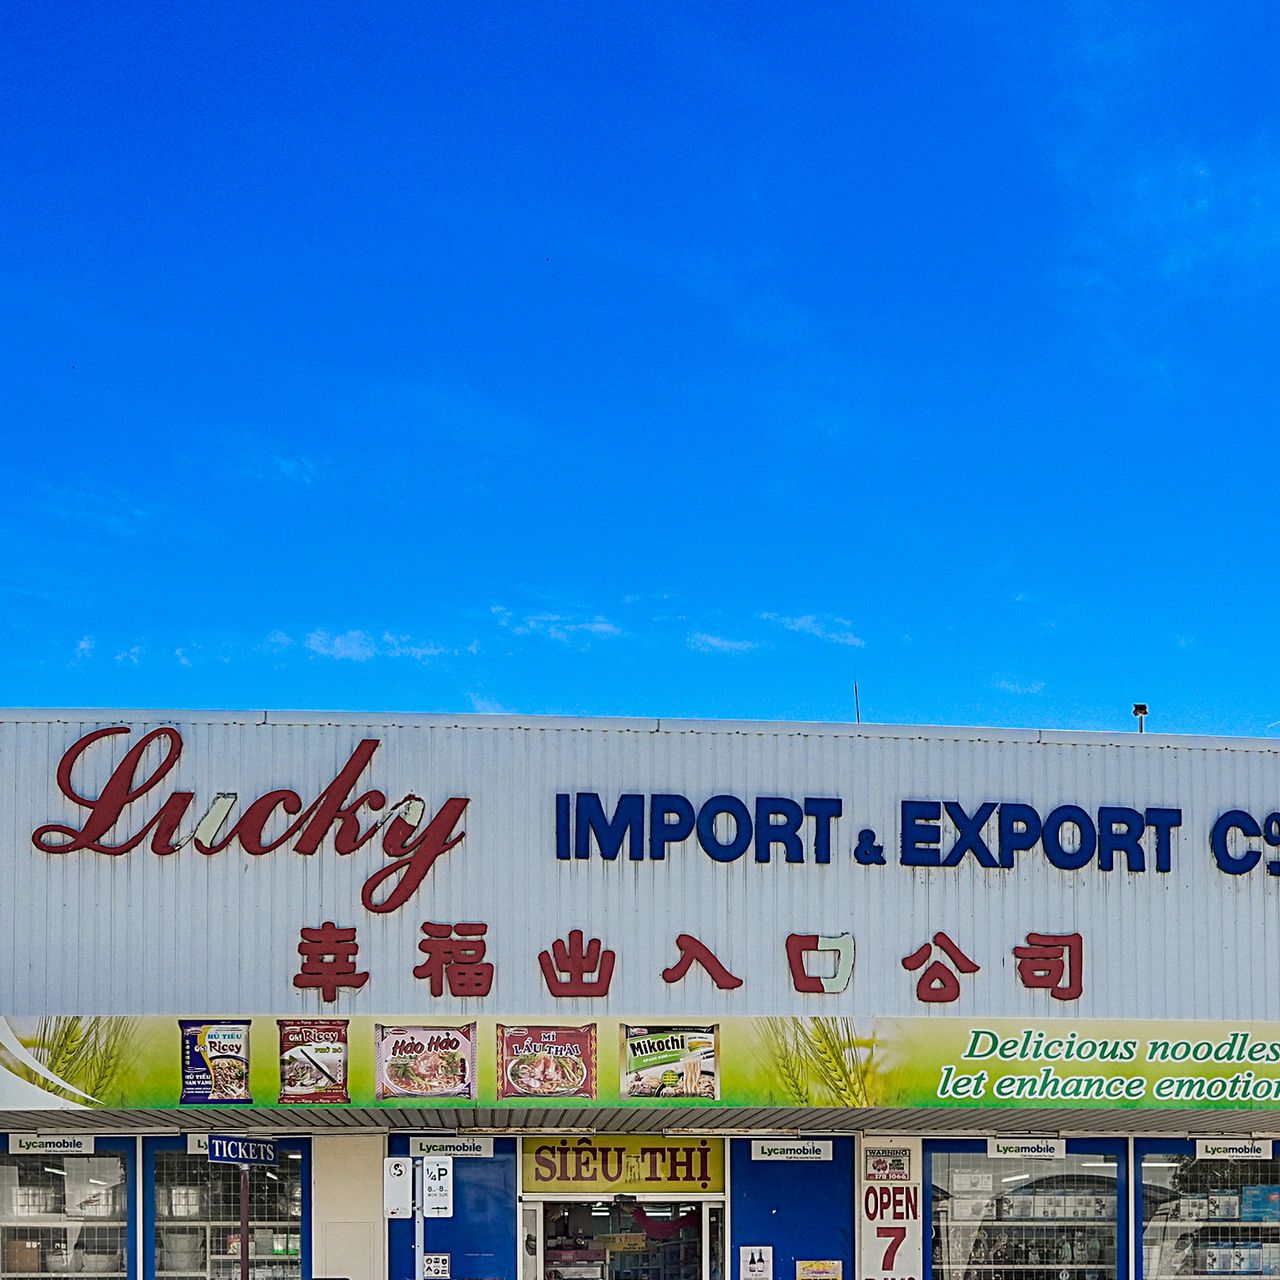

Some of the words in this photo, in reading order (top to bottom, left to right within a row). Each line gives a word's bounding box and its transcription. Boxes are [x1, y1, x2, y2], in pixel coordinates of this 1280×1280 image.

[32, 727, 470, 913] Lucky
[555, 792, 842, 865] IMPORT
[853, 827, 887, 866] &
[899, 801, 1183, 873] EXPORT
[208, 1040, 242, 1054] Ricey
[302, 1028, 339, 1044] Ricey
[629, 1034, 686, 1058] Mikochi
[964, 1030, 1138, 1063] Delicious
[938, 1067, 987, 1098] let
[993, 1068, 1147, 1100] enhance
[19, 1139, 83, 1150] Lycamobile
[211, 1139, 275, 1161] TICKETS
[420, 1142, 482, 1153] Lycamobile
[761, 1145, 822, 1156] Lycamobile
[996, 1143, 1056, 1154] Lycamobile
[1205, 1144, 1262, 1155] Lycamobile
[865, 1186, 918, 1221] OPEN
[876, 1227, 908, 1271] 7
